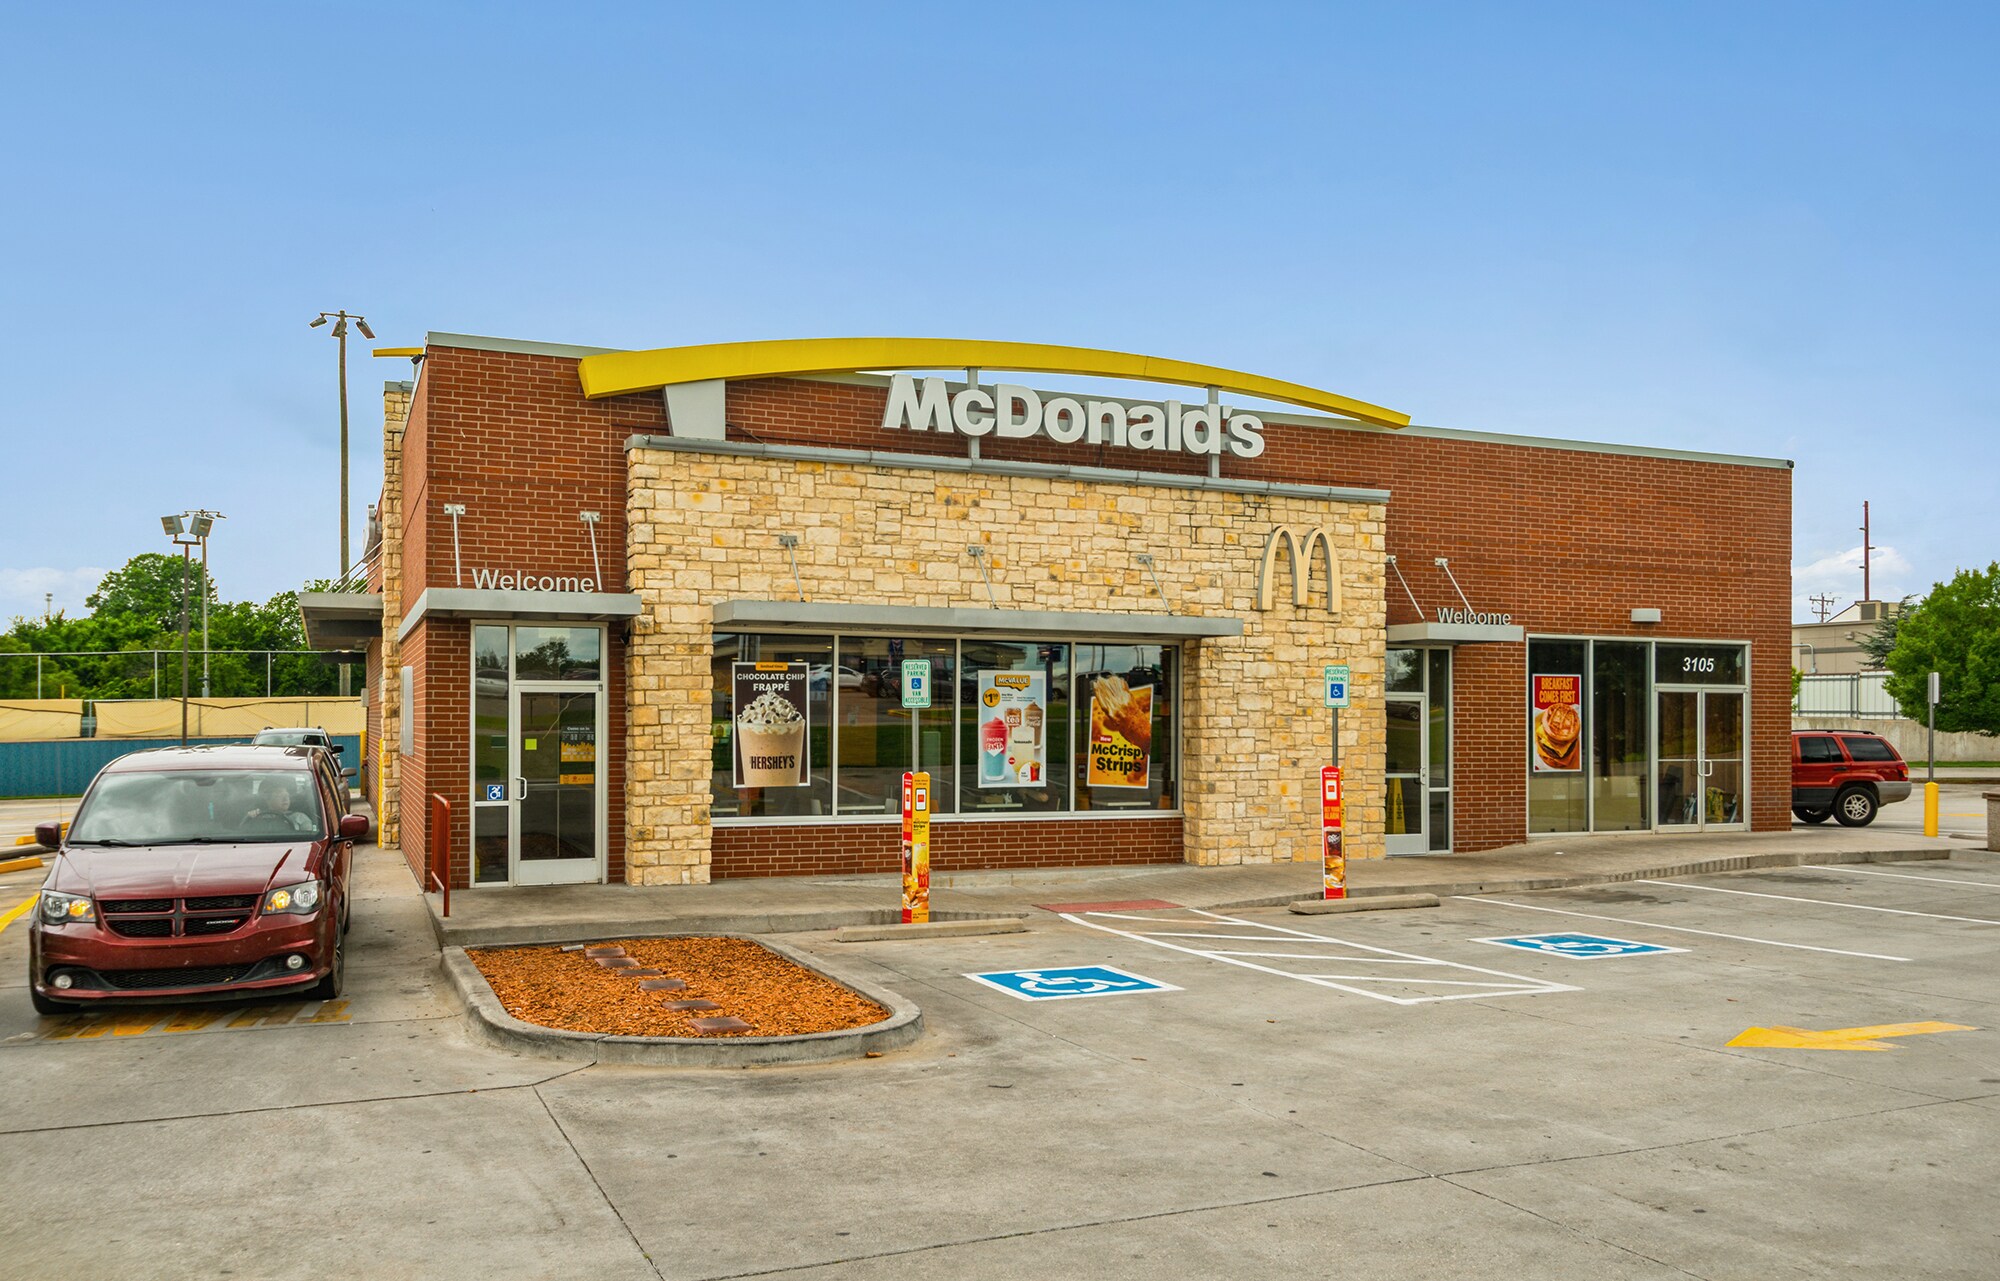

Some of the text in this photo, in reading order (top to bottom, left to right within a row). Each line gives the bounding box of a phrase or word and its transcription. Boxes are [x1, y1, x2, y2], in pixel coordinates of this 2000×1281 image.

[881, 373, 1265, 459] McDonald's
[472, 568, 595, 593] Welcome
[1436, 607, 1512, 626] Welcome
[1682, 656, 1715, 672] 3105
[753, 681, 790, 691] FRAPPÉ
[1541, 677, 1574, 690] BREAKFAST
[1539, 690, 1576, 703] COMES FIRST
[1091, 744, 1146, 760] McCrispy
[750, 755, 795, 769] HERSHEY'S
[1096, 756, 1142, 775] Strips
